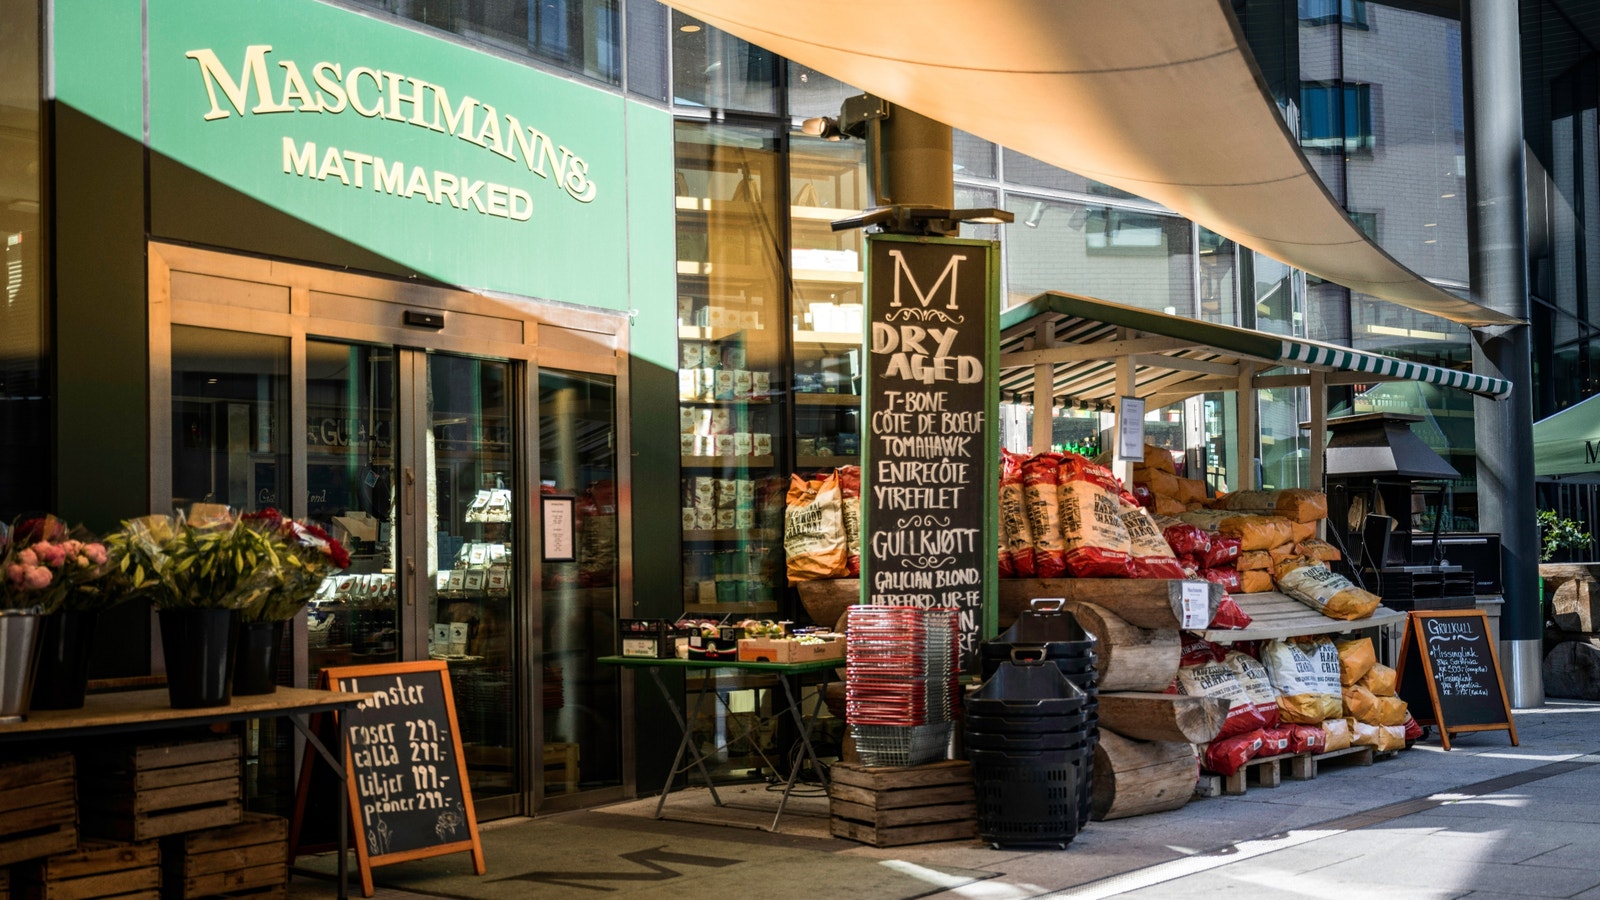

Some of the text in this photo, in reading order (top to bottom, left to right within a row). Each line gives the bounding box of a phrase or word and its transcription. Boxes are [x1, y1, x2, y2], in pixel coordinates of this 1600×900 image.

[185, 45, 597, 203] MASCHMANNS
[282, 136, 533, 222] MATMARKED
[889, 250, 967, 309] M
[871, 322, 958, 358] DRY
[880, 353, 983, 384] AGED
[884, 391, 948, 412] T-BONE
[872, 409, 985, 434] CÔTE DE BOEUF
[880, 436, 971, 459] TOMAHAWK
[878, 457, 970, 485] ENTRECÔTE
[874, 485, 965, 511] YTREFILET
[873, 528, 979, 560] GULLKJØTT
[875, 568, 981, 593] GALICIAN BLOND,
[350, 723, 395, 745] roser
[354, 745, 399, 767] calla
[359, 772, 404, 801] liljer
[364, 797, 415, 826] peoner
